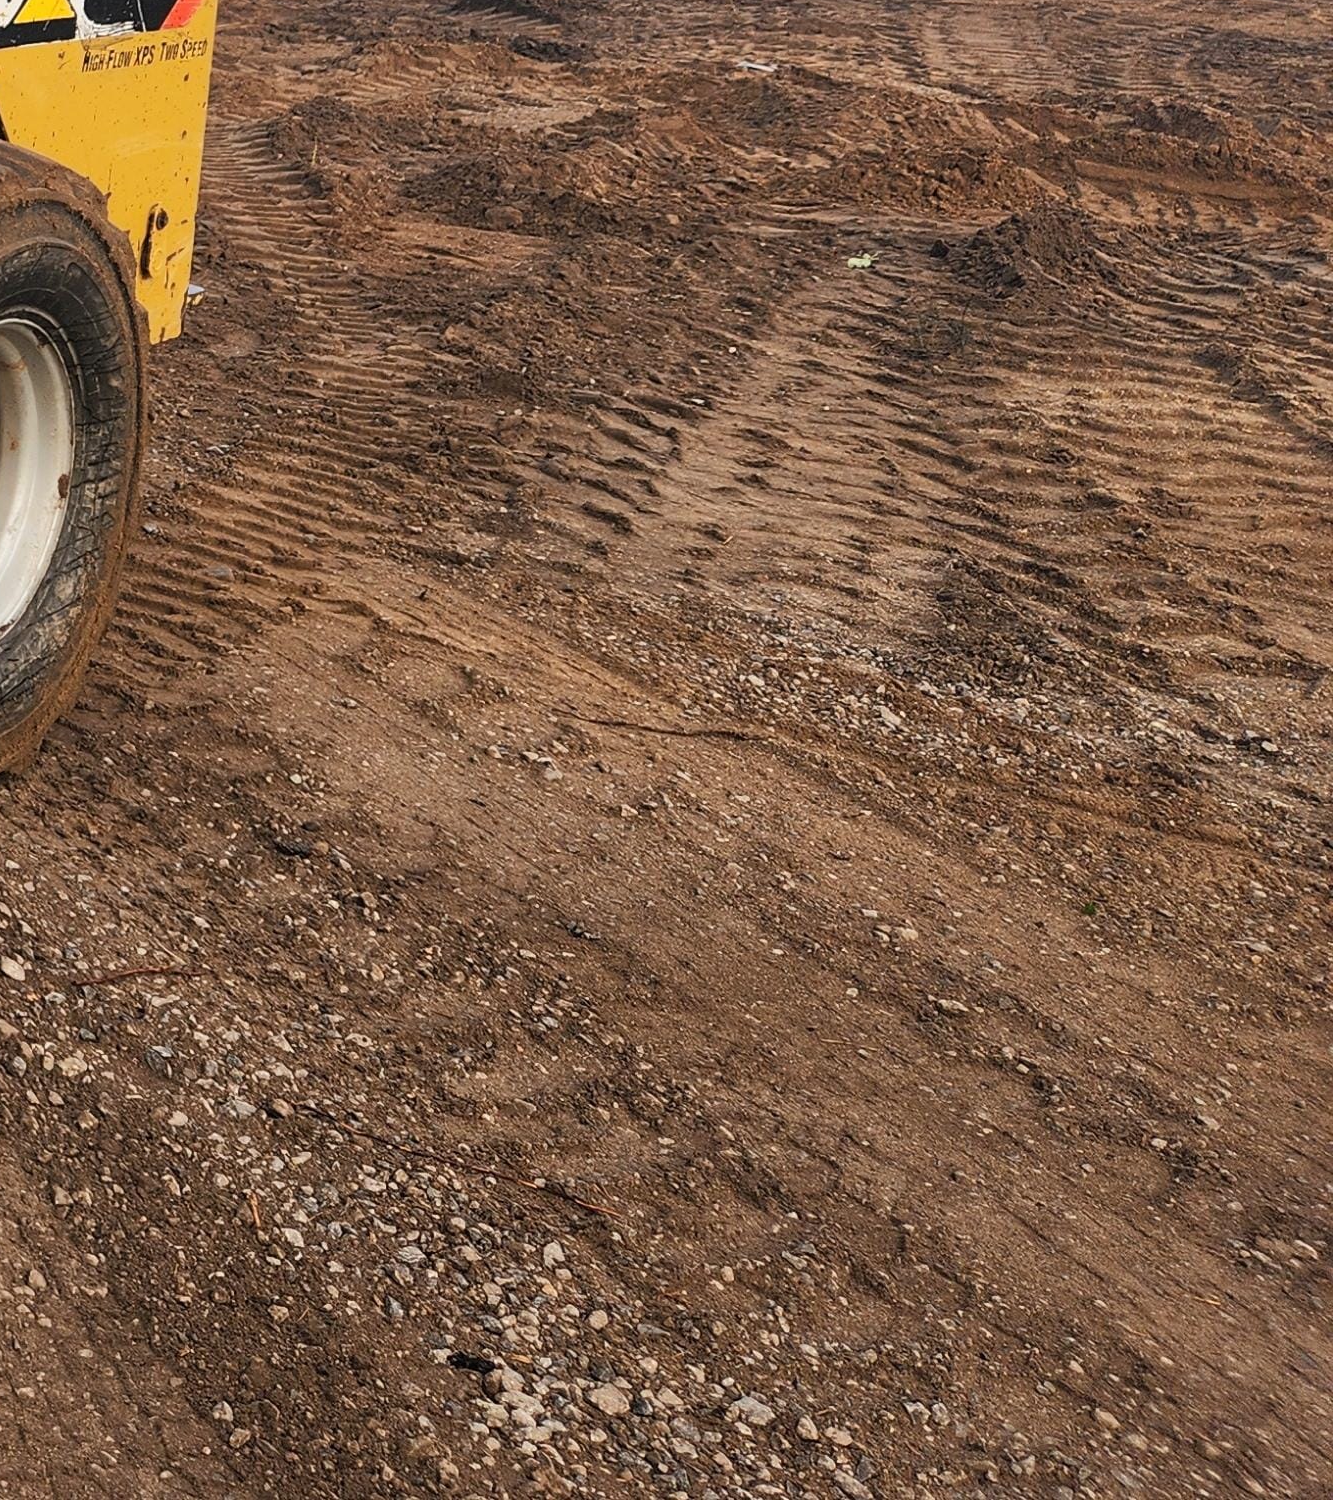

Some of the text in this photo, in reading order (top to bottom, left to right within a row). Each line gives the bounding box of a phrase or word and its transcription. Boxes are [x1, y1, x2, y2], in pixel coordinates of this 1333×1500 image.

[134, 45, 155, 66] XPS
[160, 42, 179, 62] TWO
[180, 38, 208, 60] SPEED
